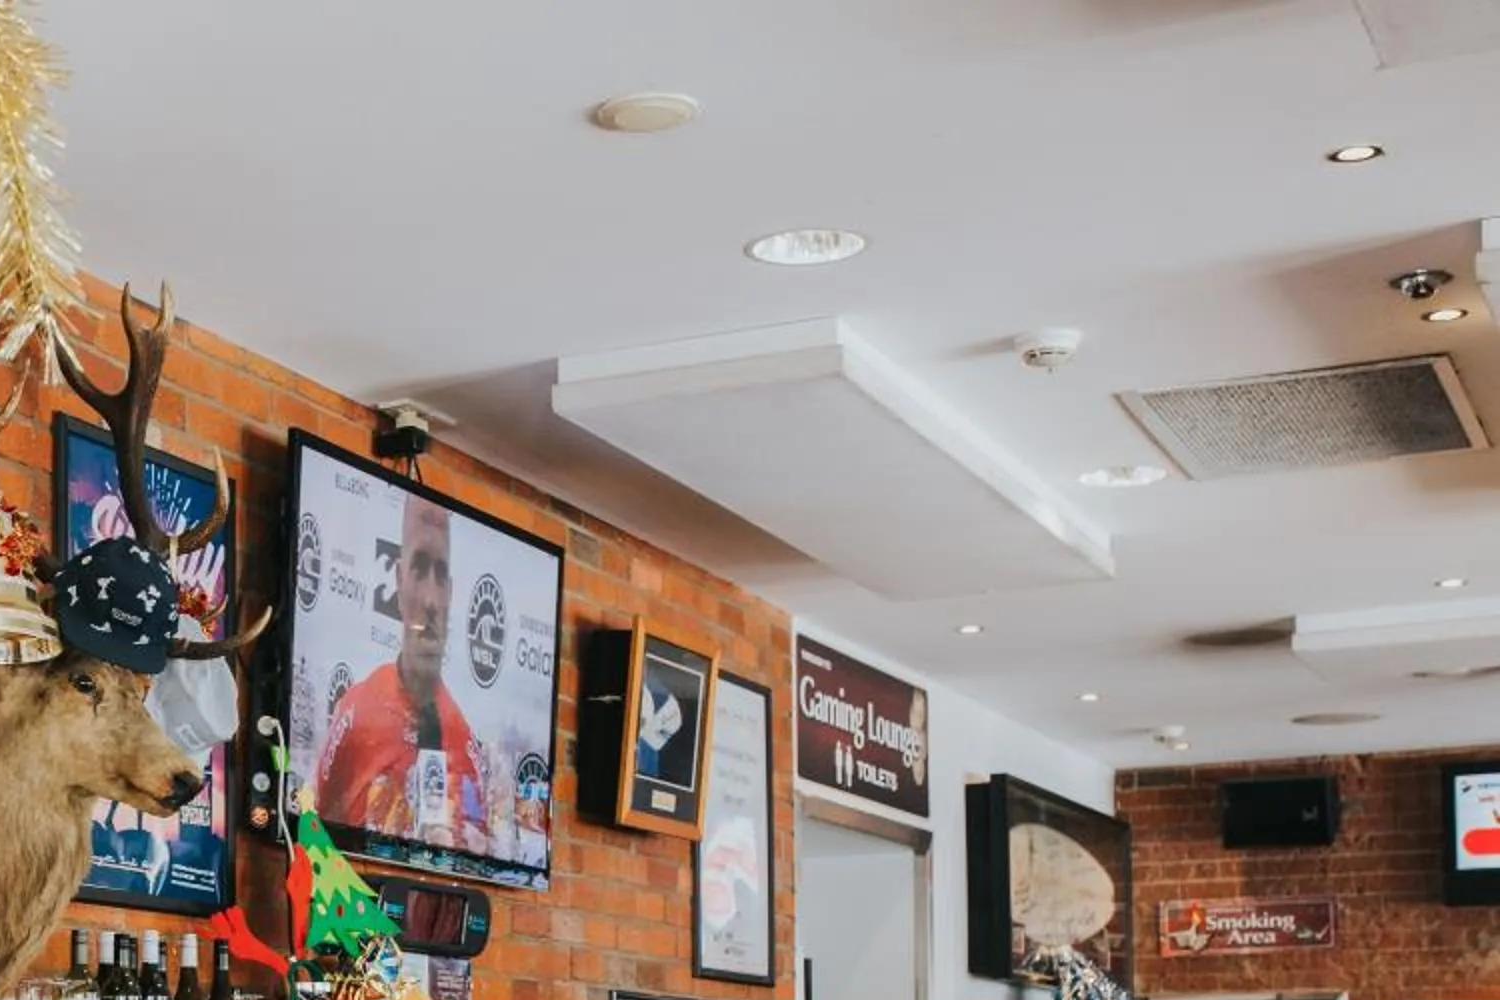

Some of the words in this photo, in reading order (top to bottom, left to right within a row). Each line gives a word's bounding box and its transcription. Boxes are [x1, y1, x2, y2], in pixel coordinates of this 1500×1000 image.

[516, 637, 551, 677] Gala
[799, 675, 866, 750] Gaming
[867, 701, 922, 769] Lounge
[856, 760, 899, 792] TOILETS
[1205, 911, 1297, 933] Smoking
[1227, 929, 1277, 945] Area
